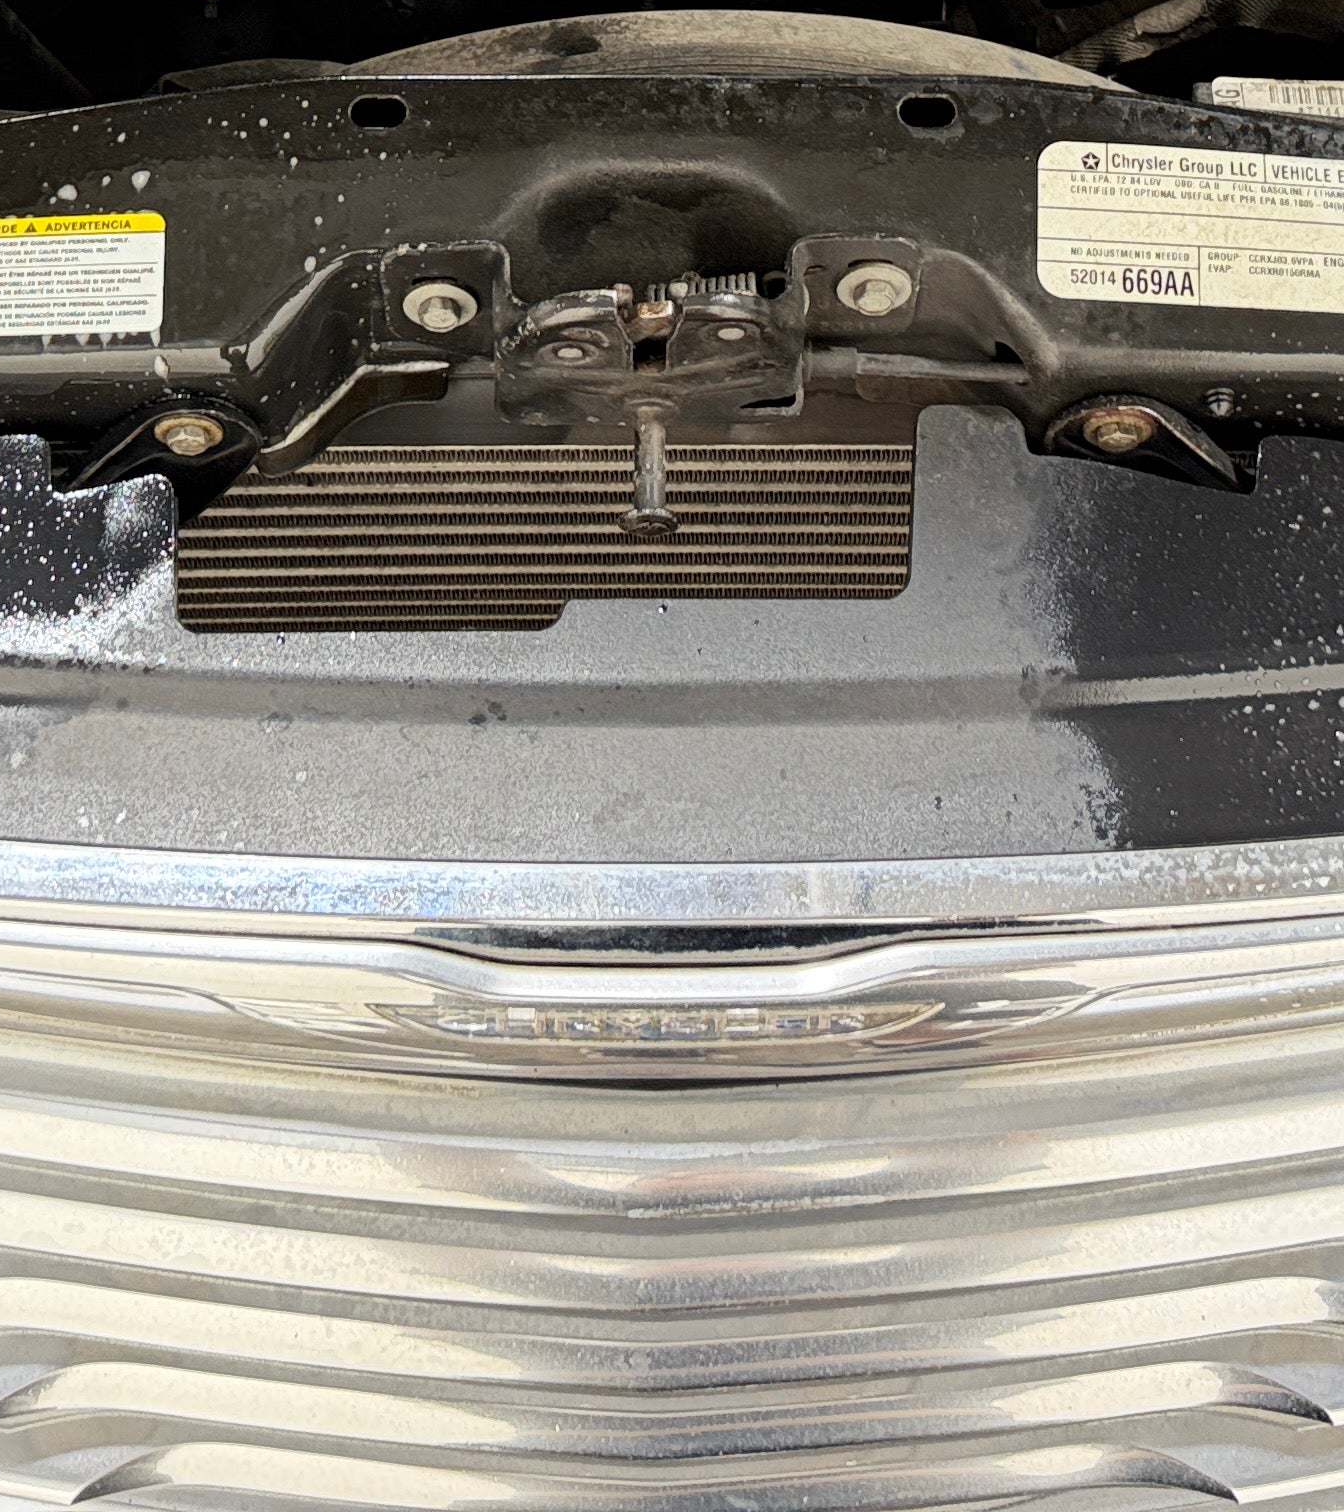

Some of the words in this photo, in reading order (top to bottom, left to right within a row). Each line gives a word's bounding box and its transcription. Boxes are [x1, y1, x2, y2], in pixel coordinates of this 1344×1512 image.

[1112, 152, 1173, 174] Chrysler
[1180, 157, 1223, 177] Group
[1230, 161, 1256, 177] LLC
[1271, 164, 1331, 182] VEHICLE
[1070, 184, 1115, 196] CERTIFIED
[1119, 188, 1130, 196] TO
[1133, 188, 1176, 199] OPTIONAL
[1181, 191, 1213, 201] USEFUL
[1217, 193, 1235, 202] LIFE
[1239, 194, 1256, 204] PER
[1259, 196, 1276, 205] EPA
[45, 219, 131, 232] ADVERTENCIA
[1086, 246, 1151, 260] ADJUSTMENTS
[1155, 251, 1189, 261] NEEDED
[1070, 267, 1116, 286] 52014
[1122, 266, 1194, 297] 669AA
